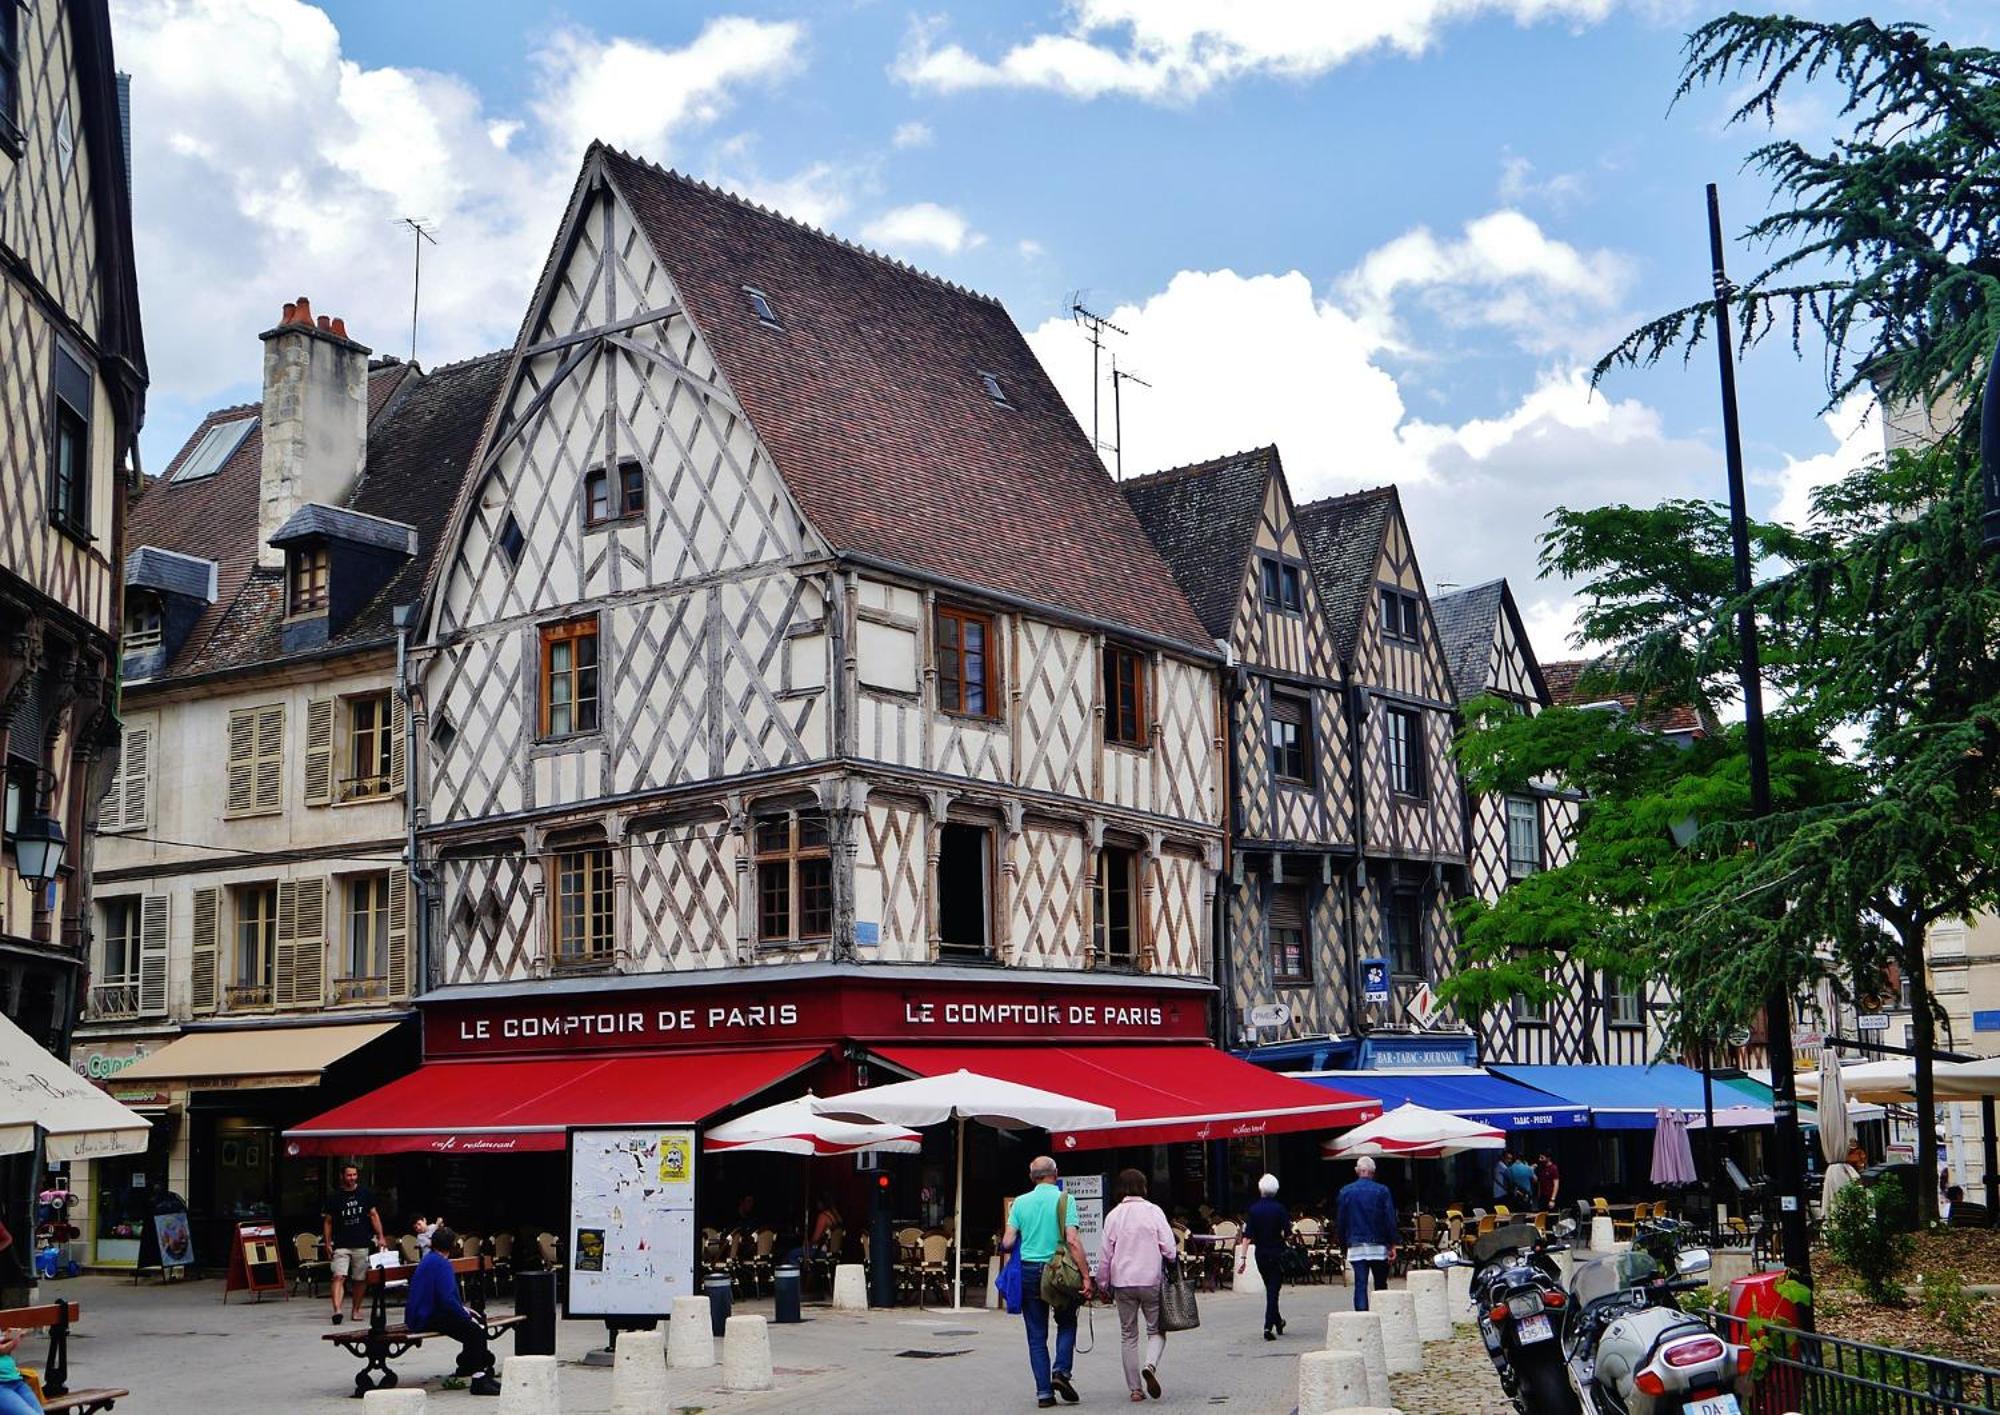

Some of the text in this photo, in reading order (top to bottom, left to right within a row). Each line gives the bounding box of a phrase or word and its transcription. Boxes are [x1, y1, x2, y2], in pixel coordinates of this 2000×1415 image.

[461, 1004, 797, 1039] LE COMPTOIR DE PARIS
[905, 1003, 1162, 1025] LE COMPTOIR DE PARIS
[462, 1139, 516, 1149] restaurant
